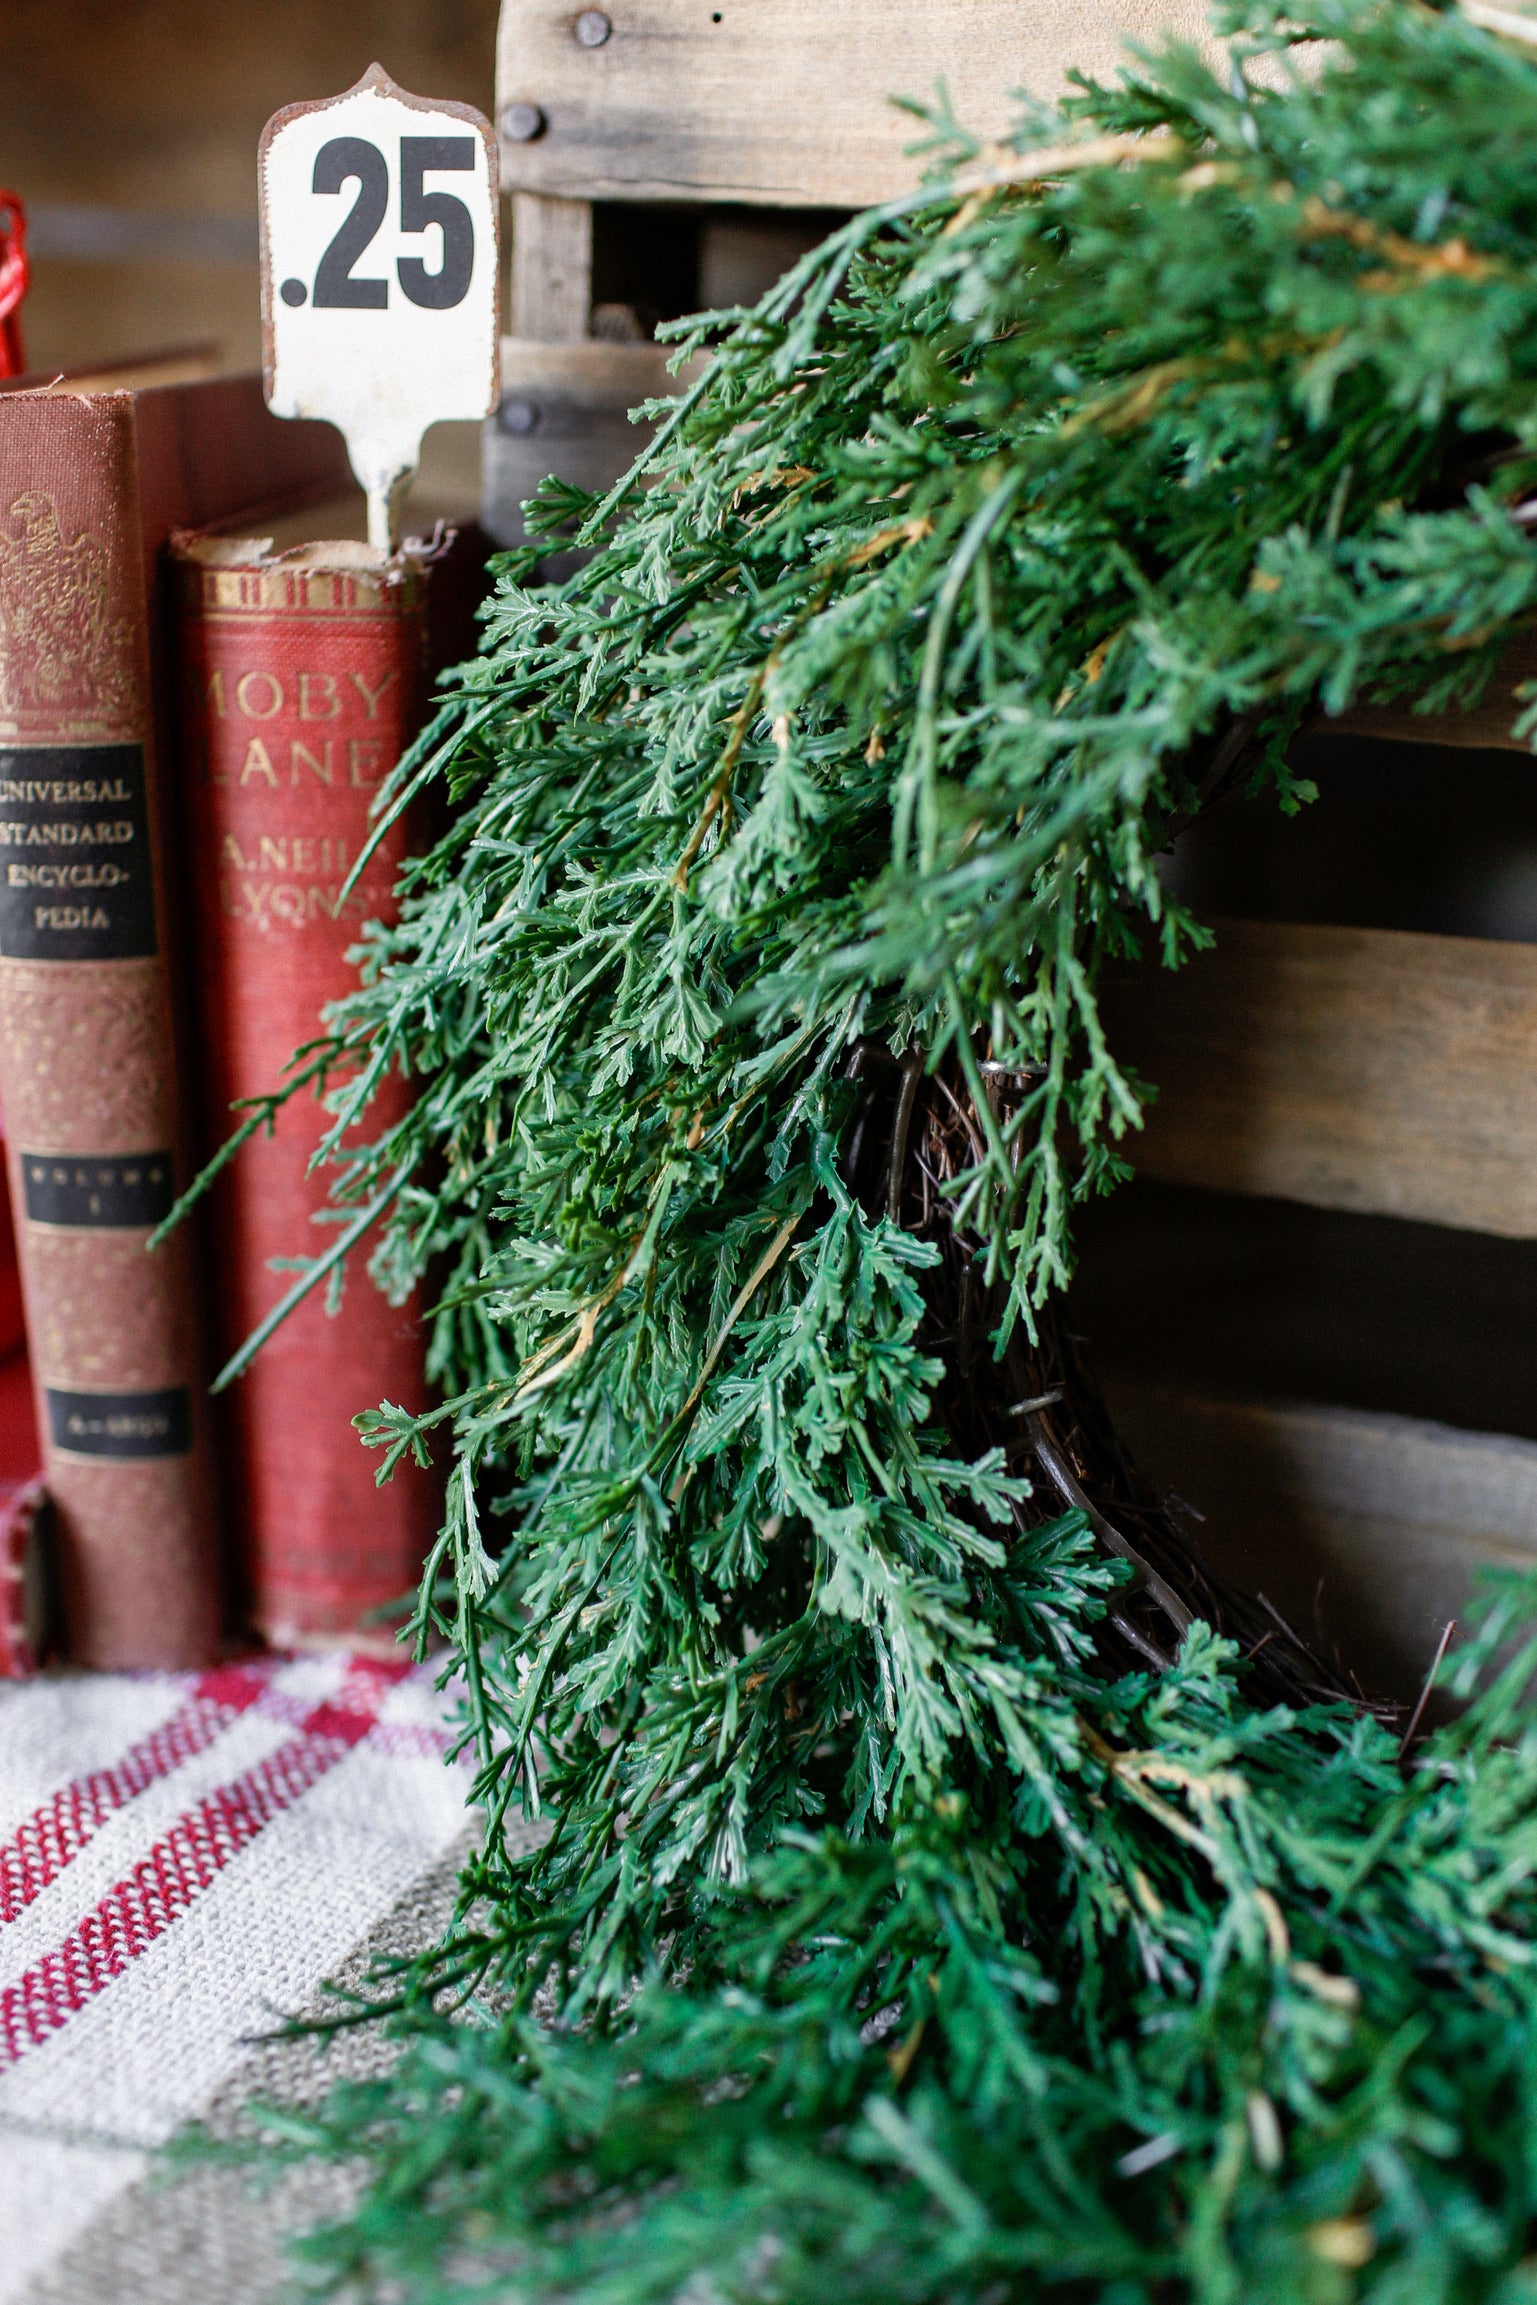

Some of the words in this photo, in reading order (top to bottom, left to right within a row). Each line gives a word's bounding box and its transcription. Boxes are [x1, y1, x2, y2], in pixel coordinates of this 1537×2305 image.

[280, 136, 475, 310] .25
[0, 820, 135, 845] STANDARD
[34, 905, 110, 930] PEDIA
